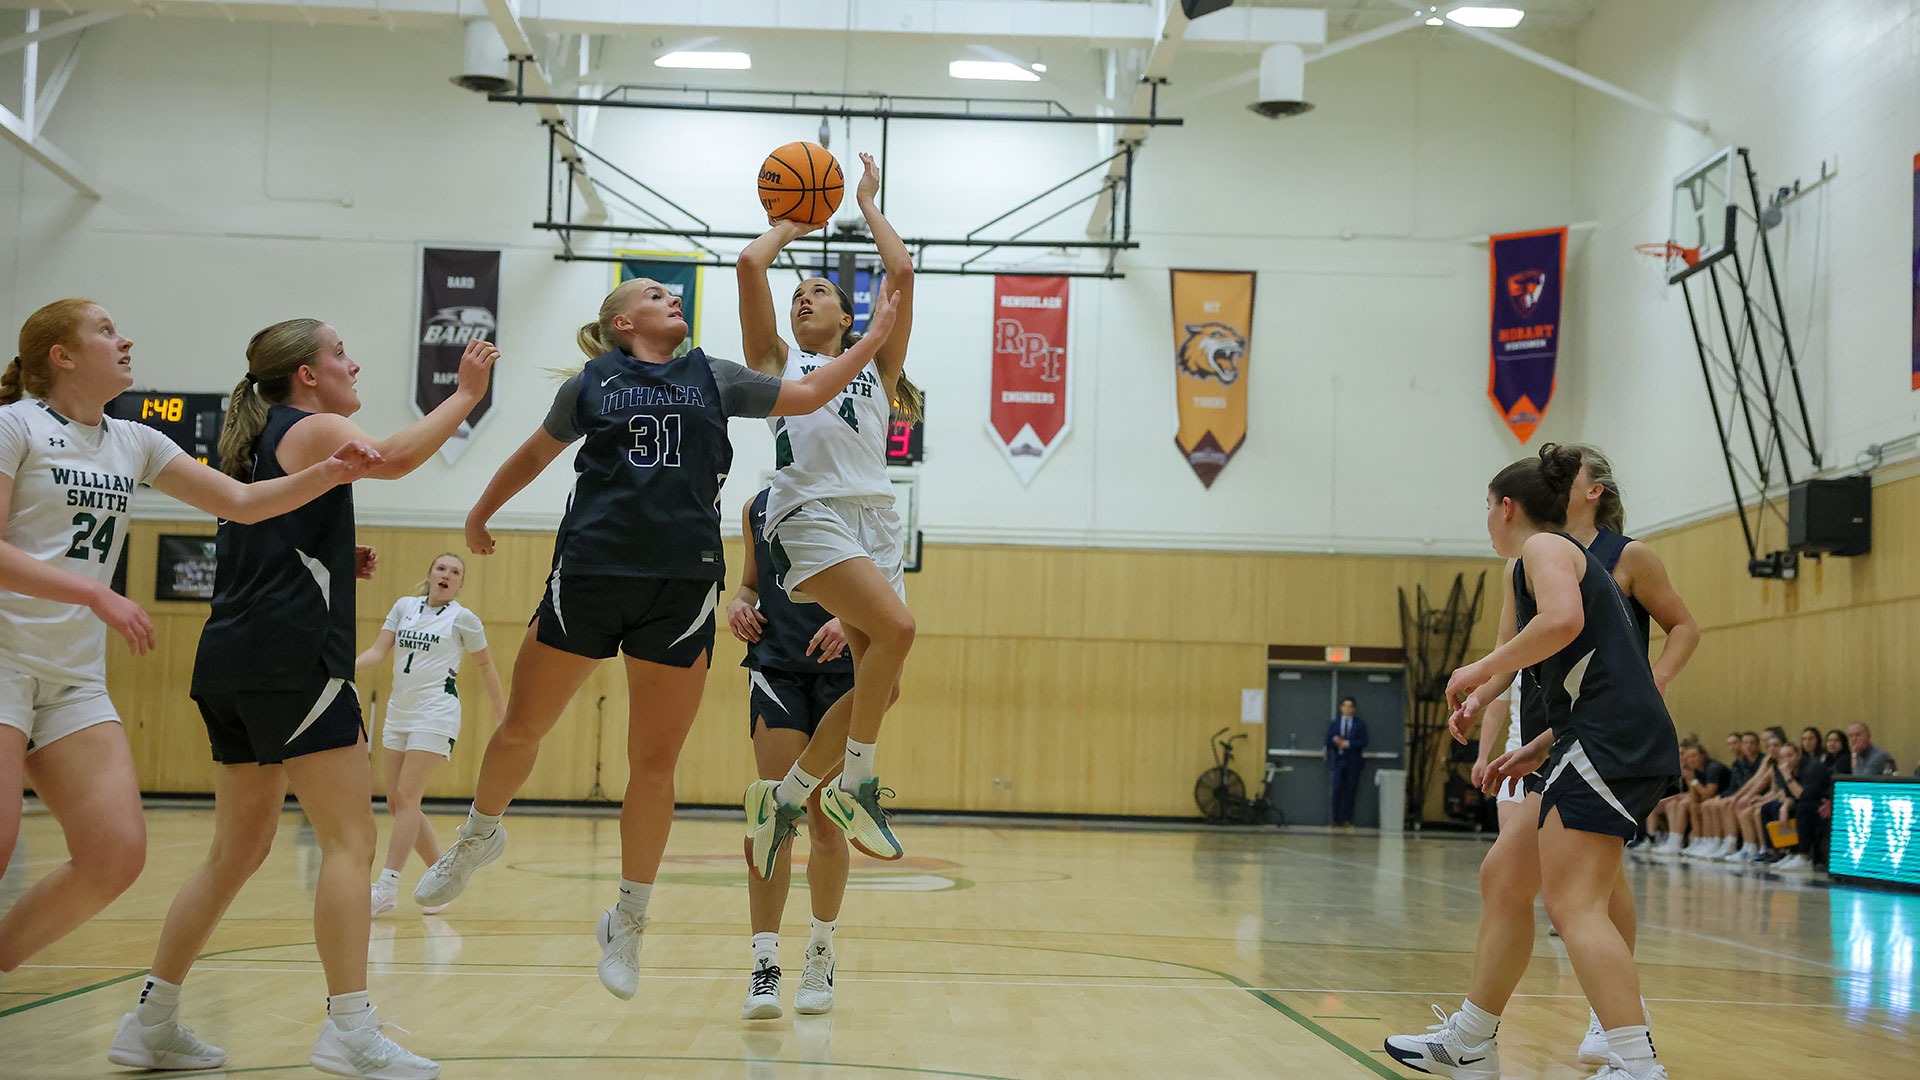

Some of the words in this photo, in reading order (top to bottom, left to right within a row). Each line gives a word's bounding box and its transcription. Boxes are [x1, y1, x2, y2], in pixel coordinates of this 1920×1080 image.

[423, 325, 489, 344] BARD
[996, 318, 1064, 382] RPI
[433, 372, 459, 385] RAPT
[142, 398, 184, 422] 1:48
[601, 384, 705, 415] ITHACA
[838, 397, 859, 434] 4
[628, 414, 681, 467] 31
[886, 420, 910, 456] 3
[51, 467, 134, 495] WILLIAM
[67, 489, 128, 513] SMITH
[65, 512, 116, 564] 24
[398, 630, 440, 644] WILLIAM
[399, 639, 430, 651] SMITH
[403, 652, 415, 674] 1
